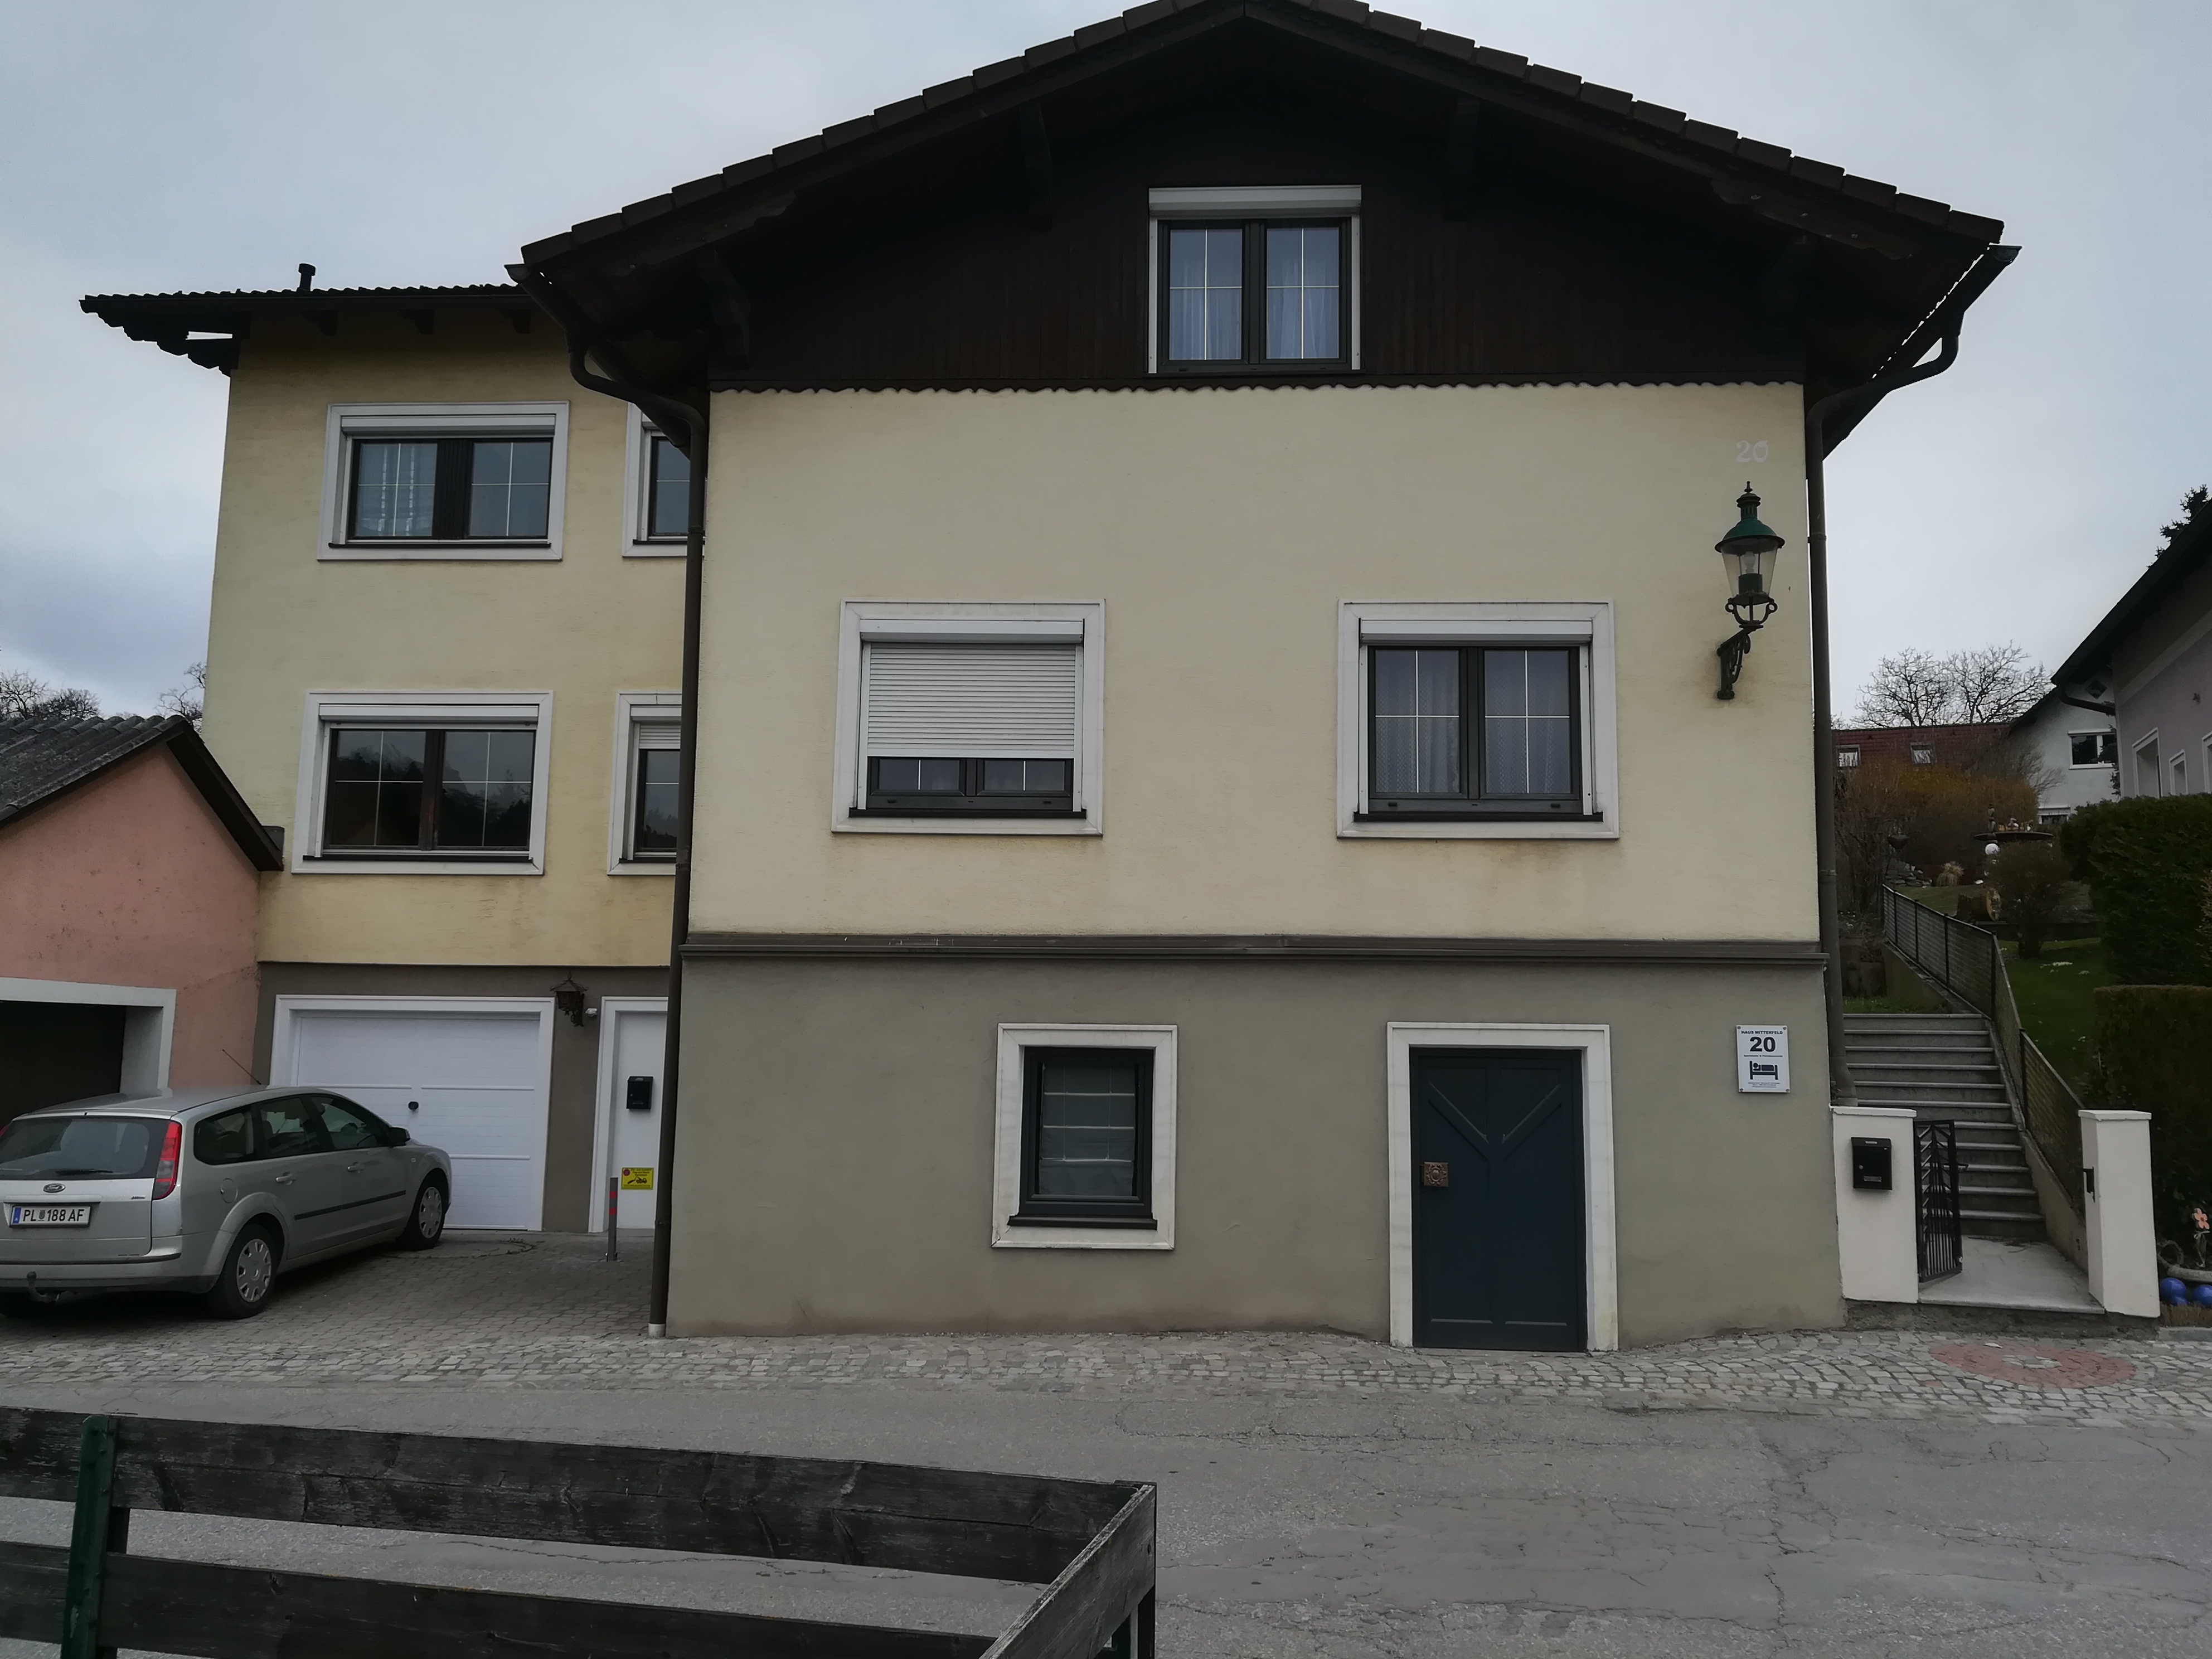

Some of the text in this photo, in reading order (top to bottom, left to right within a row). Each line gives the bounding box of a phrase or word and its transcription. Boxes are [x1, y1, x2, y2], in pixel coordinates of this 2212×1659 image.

[1736, 440, 1768, 463] 20
[1749, 1036, 1776, 1052] 20
[23, 1209, 36, 1221] PL
[47, 1209, 66, 1221] 188
[67, 1209, 85, 1221] AF
